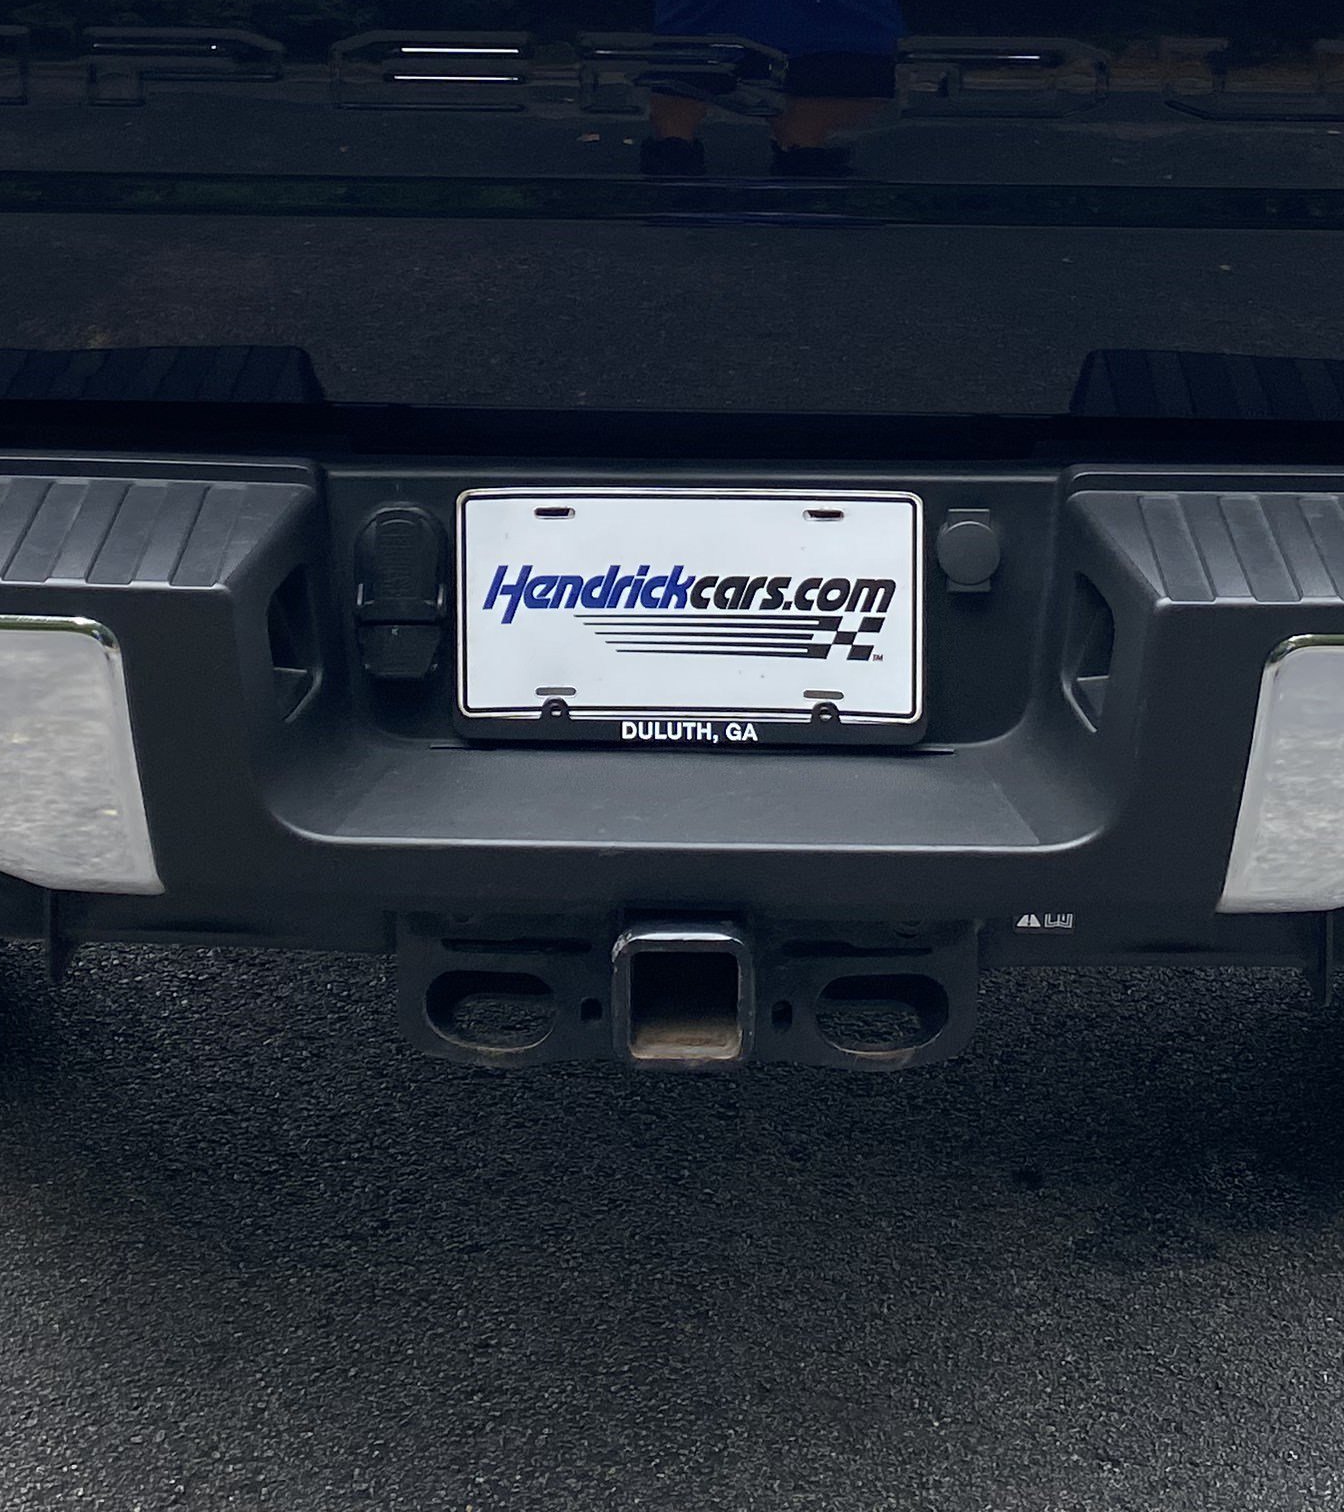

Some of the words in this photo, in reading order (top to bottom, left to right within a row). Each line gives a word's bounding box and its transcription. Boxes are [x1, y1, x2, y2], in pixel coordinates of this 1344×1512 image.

[482, 565, 896, 624] Hendrickcars.com
[621, 721, 719, 744] DULUTH,
[725, 722, 758, 741] GA
